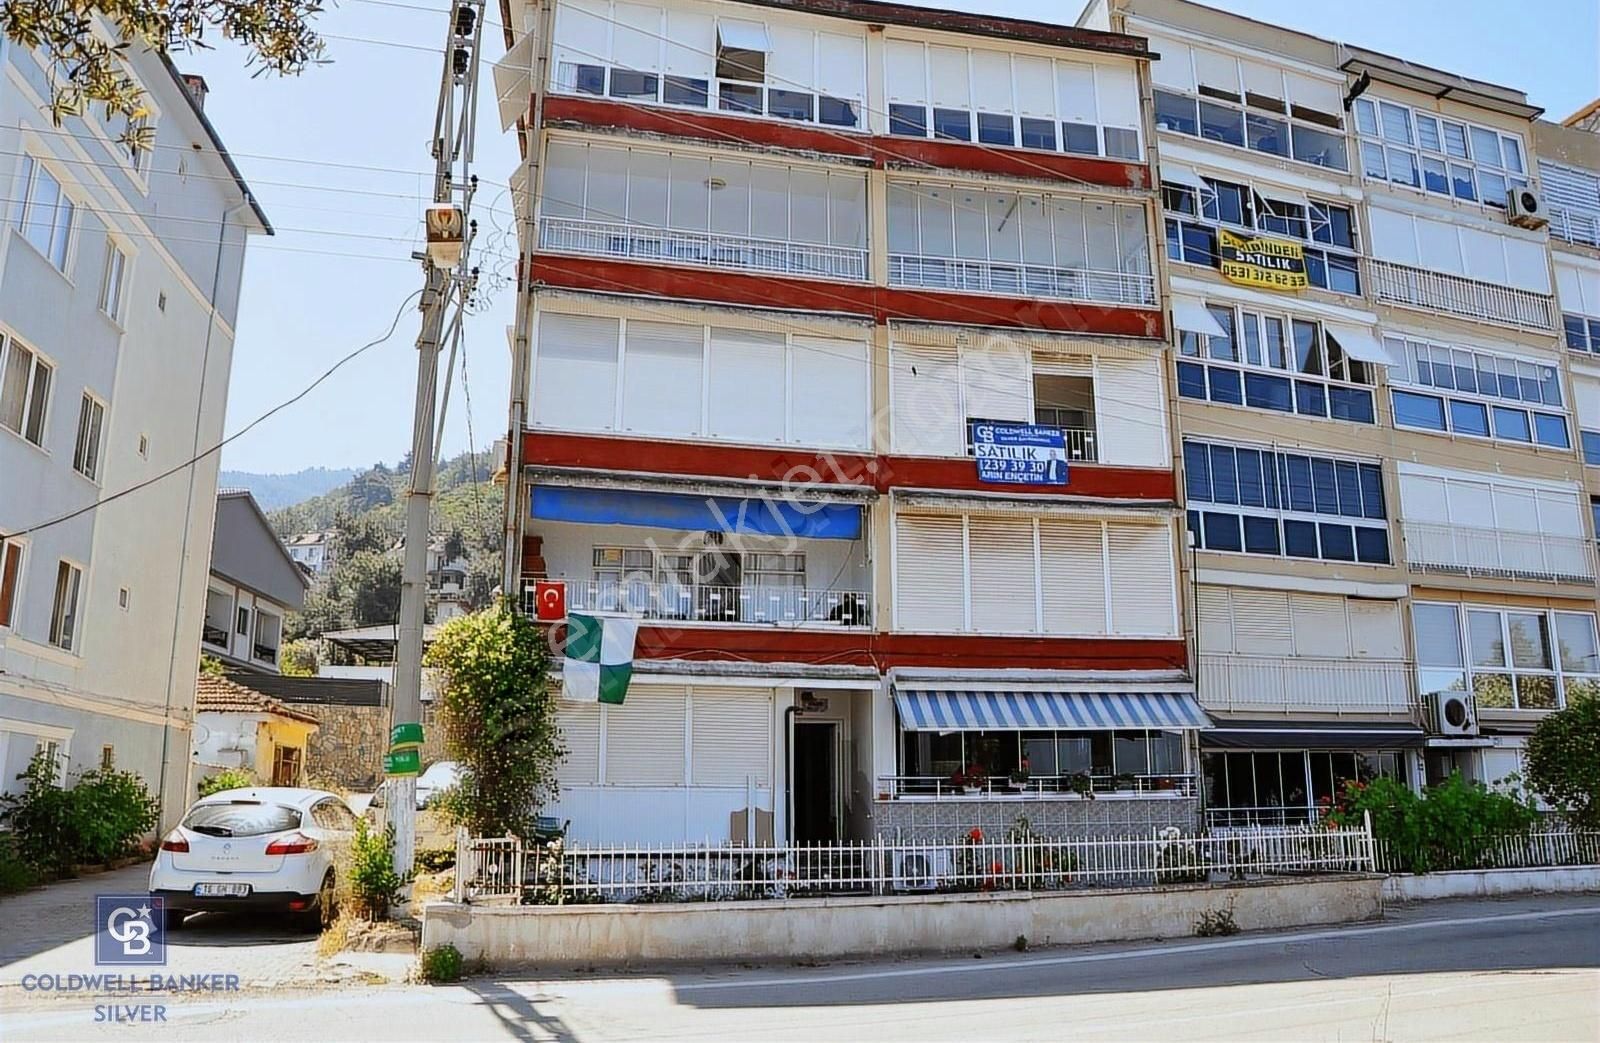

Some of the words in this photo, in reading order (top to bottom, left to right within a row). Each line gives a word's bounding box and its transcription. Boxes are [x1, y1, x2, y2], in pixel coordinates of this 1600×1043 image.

[1236, 250, 1291, 270] SATILIK
[1223, 264, 1250, 279] 0531
[1253, 269, 1272, 282] 372
[1290, 275, 1305, 287] 33
[995, 426, 1033, 436] COLDWELL
[978, 444, 1037, 460] SATILIK
[1011, 461, 1026, 472] 39
[1030, 462, 1045, 473] 30
